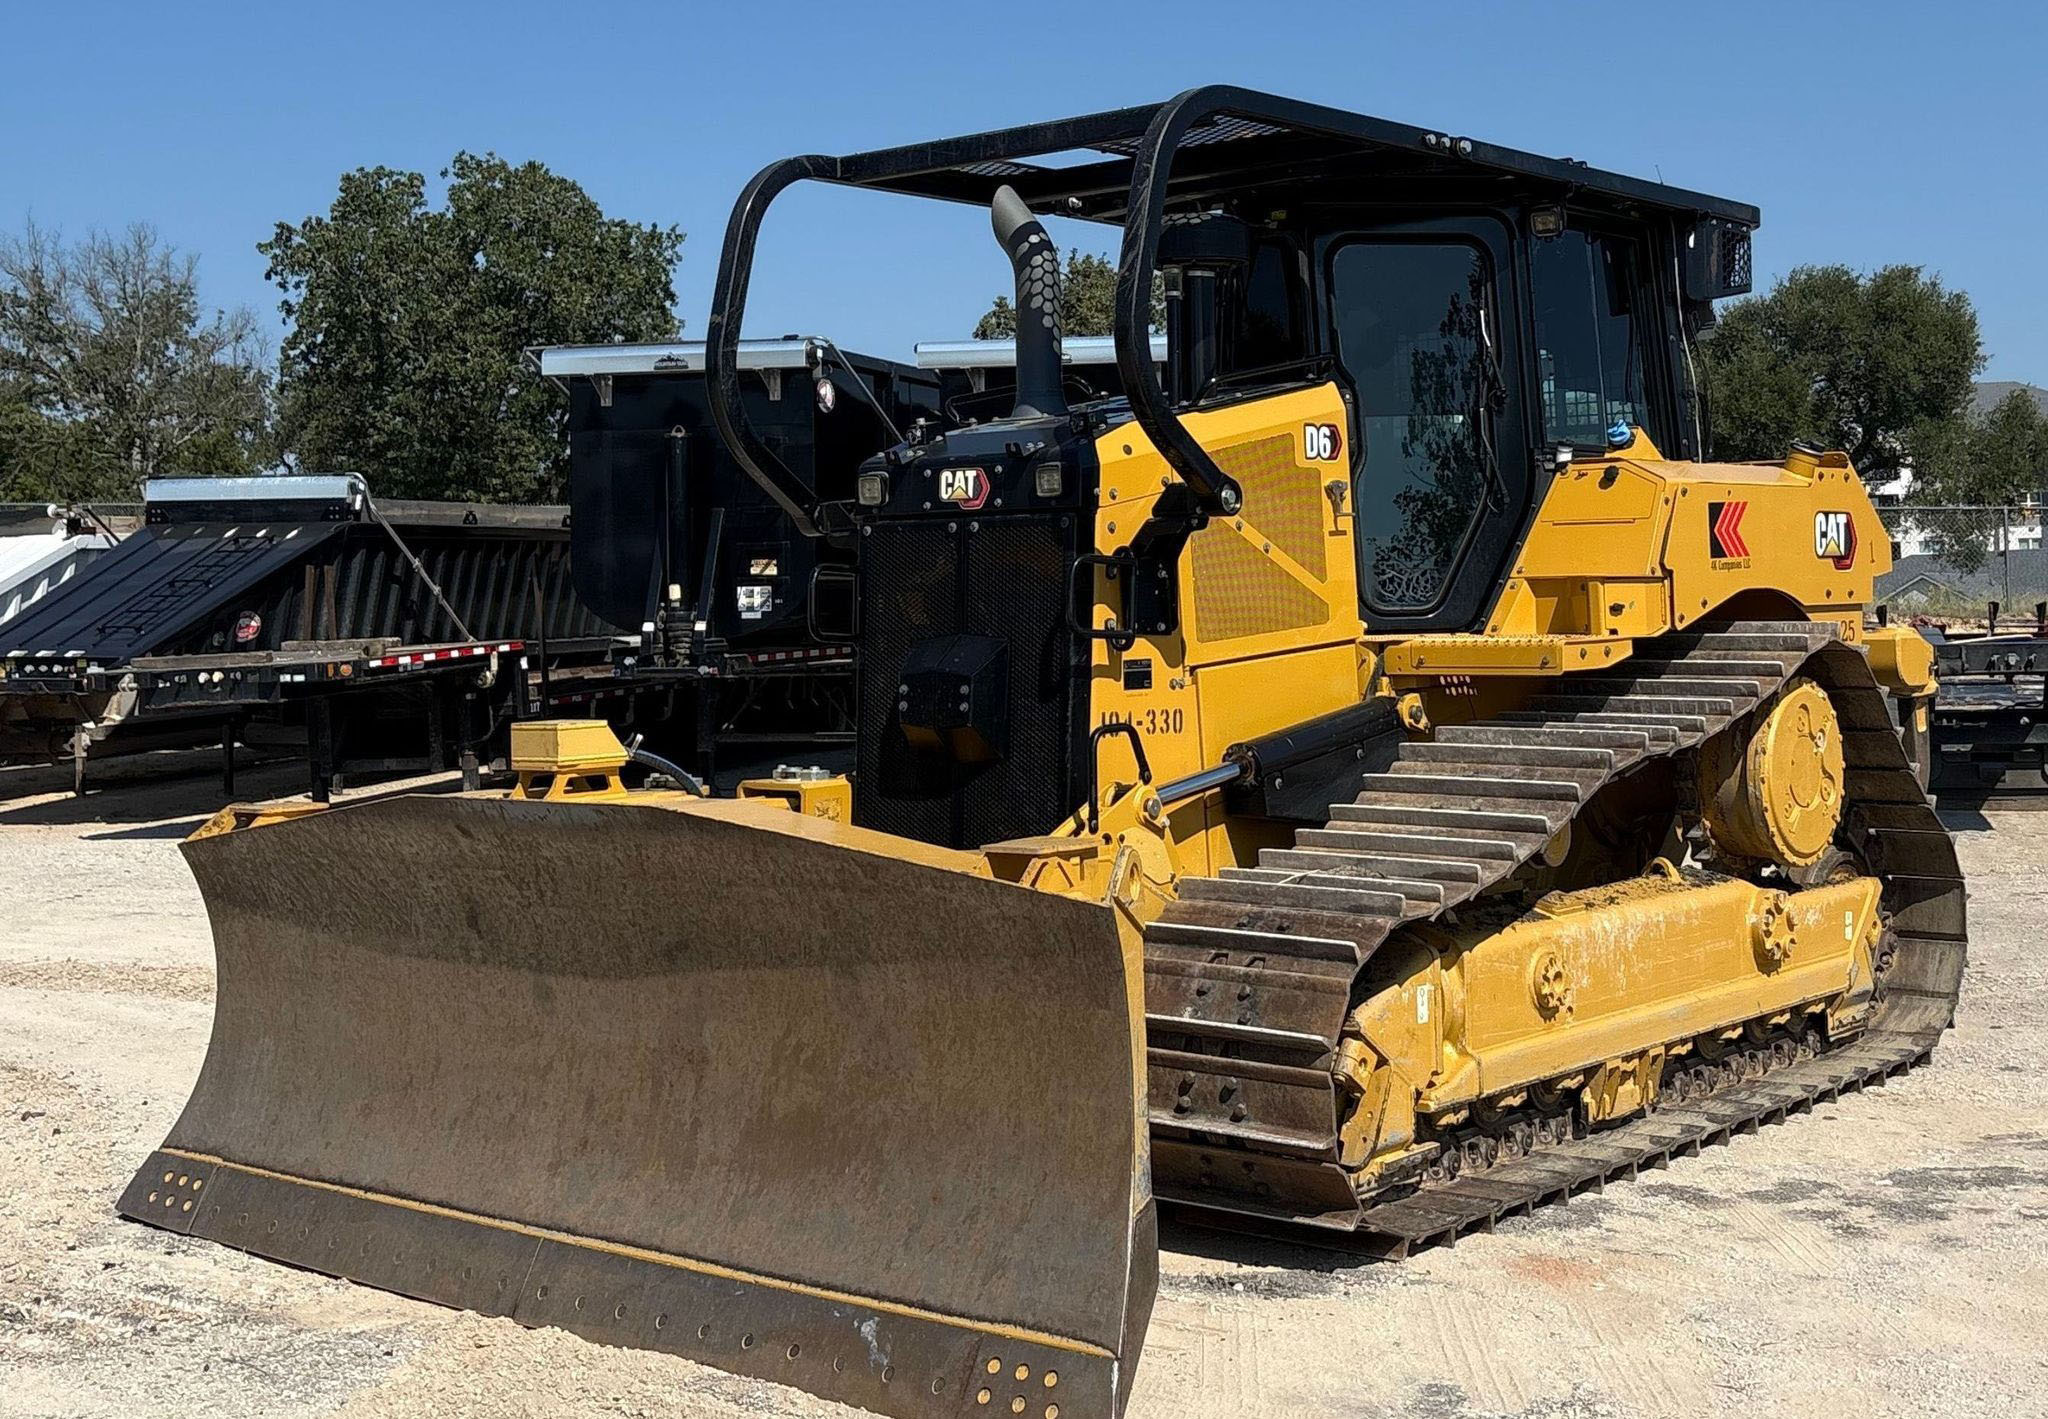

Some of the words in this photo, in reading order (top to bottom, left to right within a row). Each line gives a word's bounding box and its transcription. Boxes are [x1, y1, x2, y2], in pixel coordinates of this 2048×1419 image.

[1304, 424, 1332, 460] D6
[941, 469, 978, 500] CAT
[1815, 512, 1848, 557] CAT
